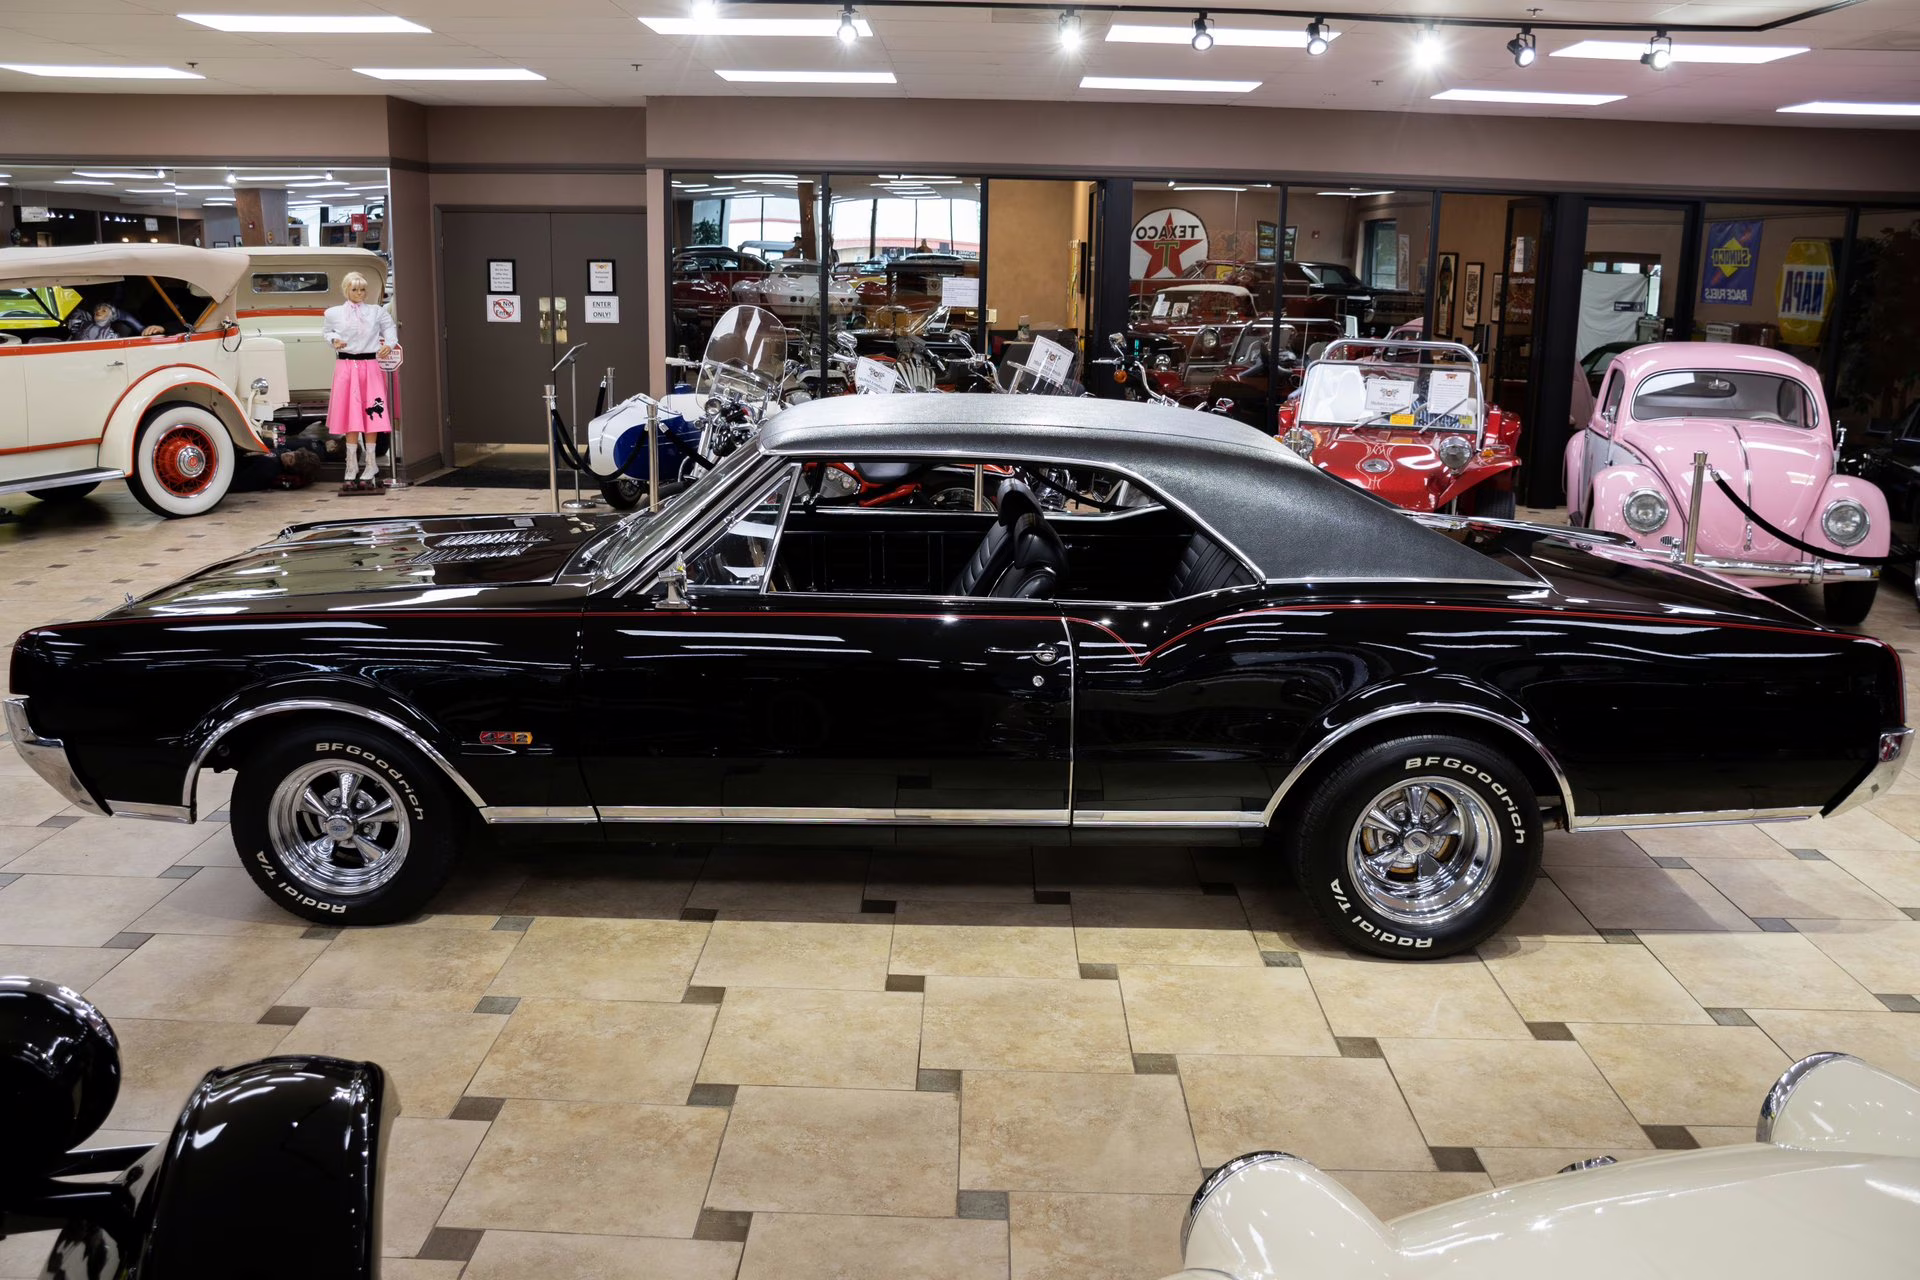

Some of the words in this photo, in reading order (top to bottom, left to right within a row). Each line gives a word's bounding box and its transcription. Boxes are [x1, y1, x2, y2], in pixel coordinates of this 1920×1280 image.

[316, 742, 424, 820] BFGoodrich
[1405, 756, 1525, 844] BFGoodrich
[256, 850, 277, 880] T/A
[278, 882, 347, 914] Radial
[1330, 878, 1351, 914] T/A
[1351, 915, 1433, 948] Radial
